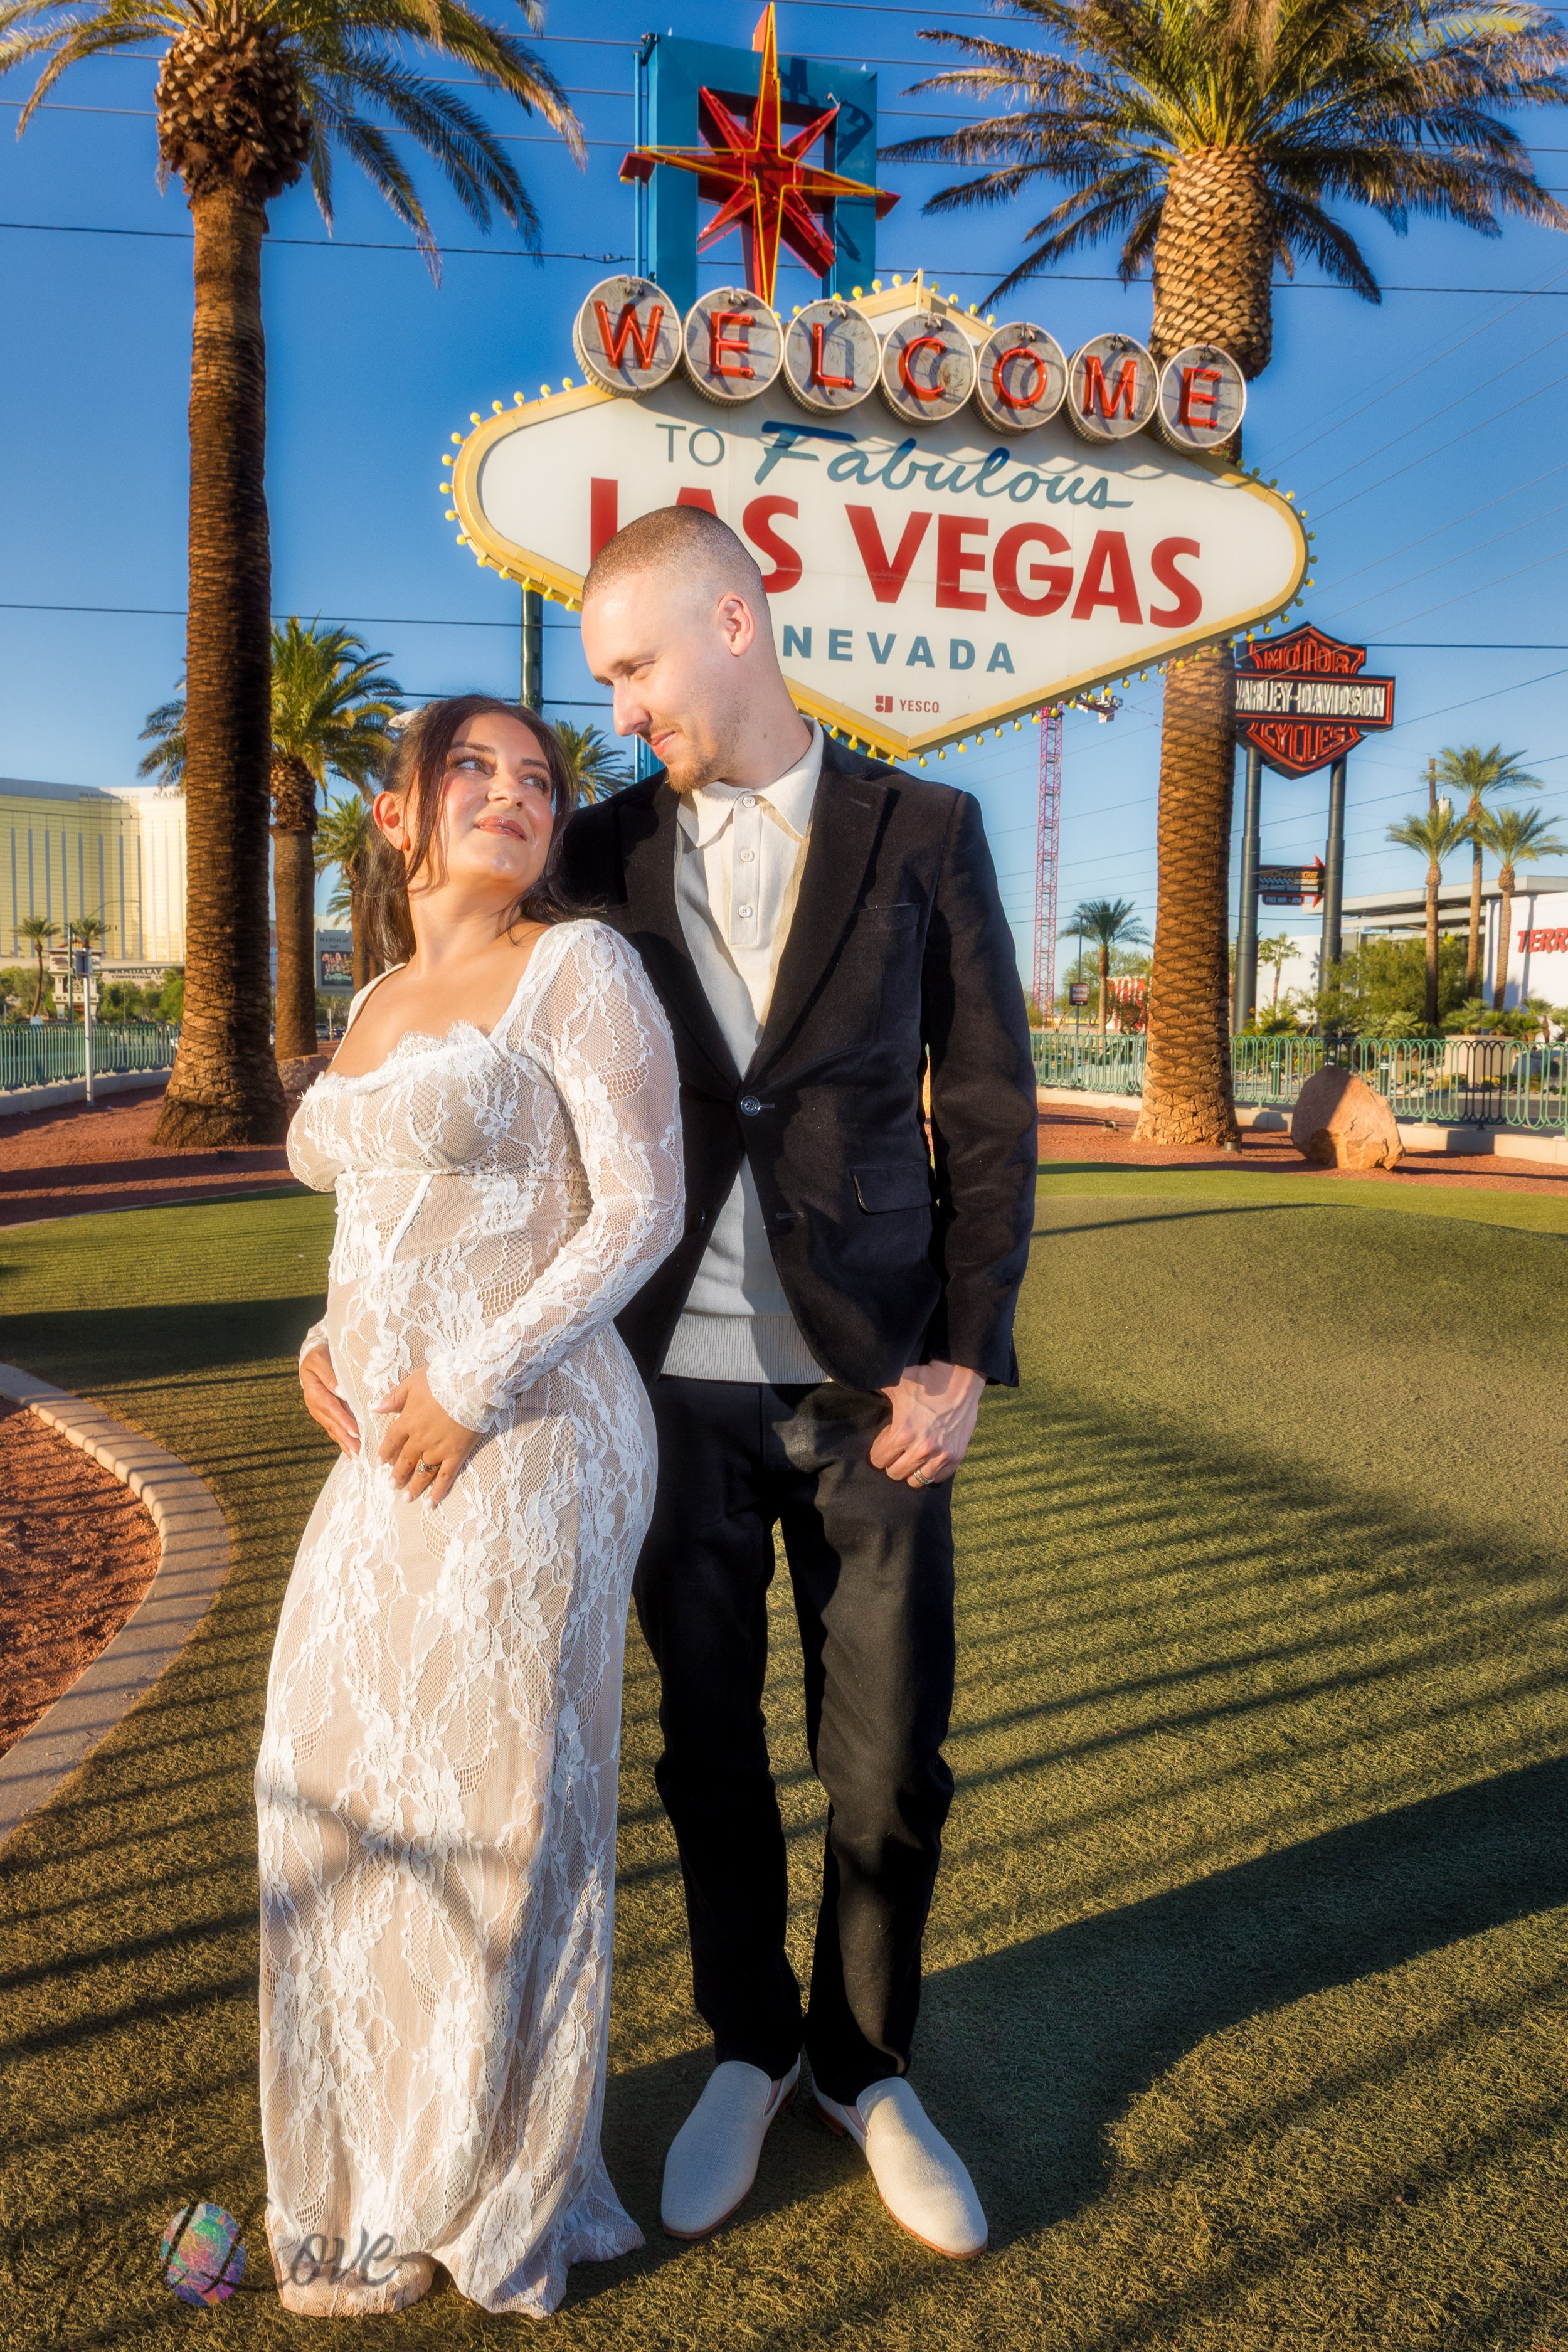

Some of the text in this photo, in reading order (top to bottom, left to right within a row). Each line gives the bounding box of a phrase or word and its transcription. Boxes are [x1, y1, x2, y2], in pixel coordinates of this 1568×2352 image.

[593, 299, 1222, 430] WELCOME
[655, 419, 1135, 509] TO Fabulous
[845, 504, 1203, 628] VEGAS
[783, 625, 1015, 674] NEVADA
[1263, 638, 1350, 674] MOTOR
[899, 699, 940, 714] YESCO
[1235, 679, 1385, 718] ARLEY-DAVIDSON
[1261, 723, 1346, 763] CYCLES
[1517, 927, 1568, 953] TERR
